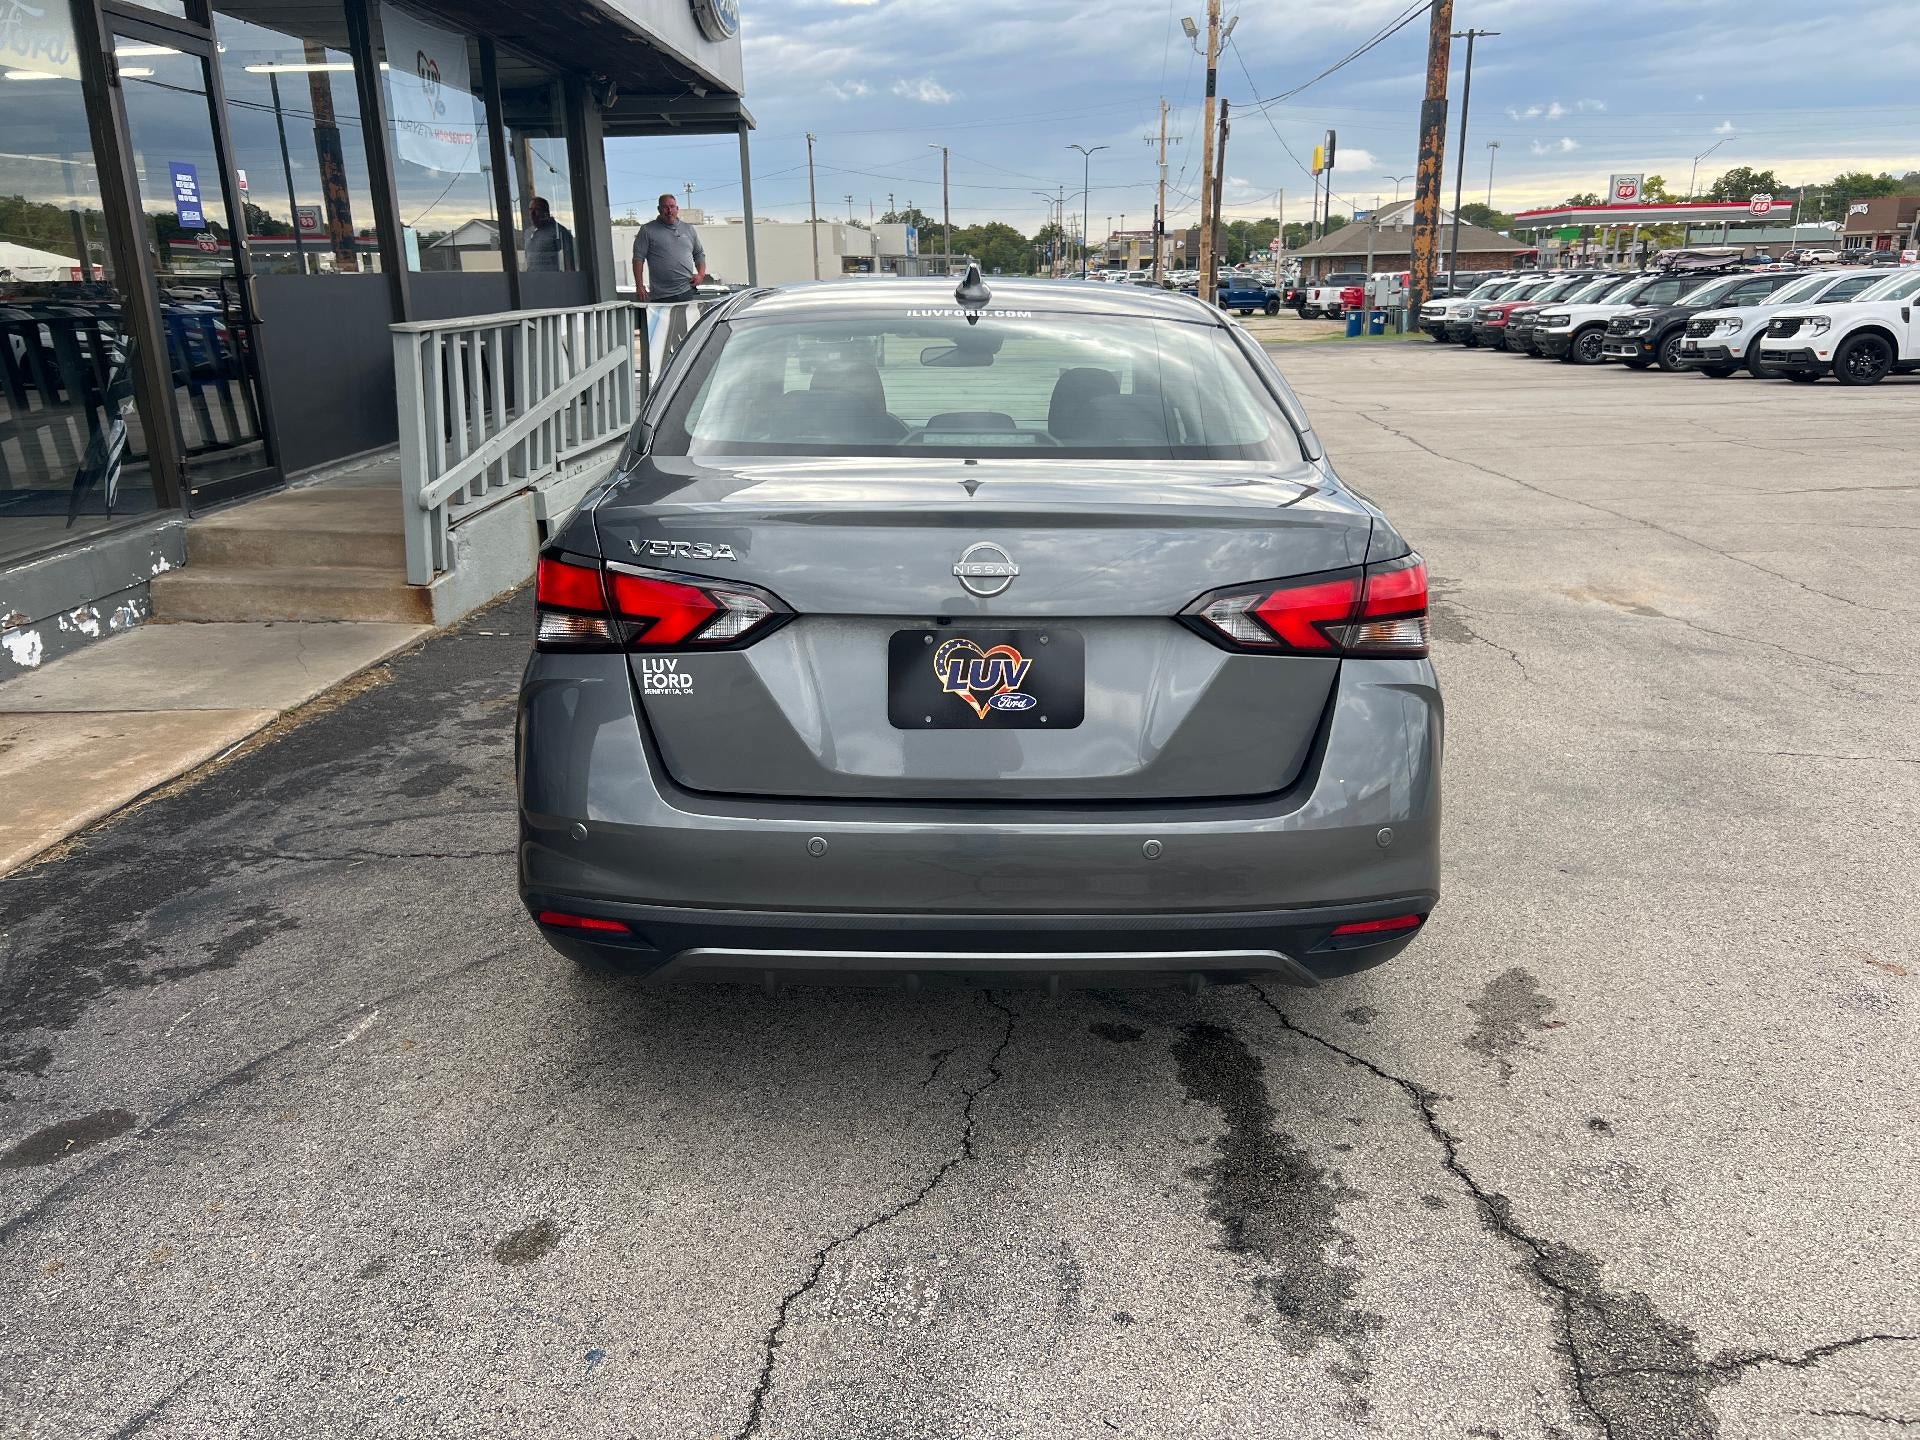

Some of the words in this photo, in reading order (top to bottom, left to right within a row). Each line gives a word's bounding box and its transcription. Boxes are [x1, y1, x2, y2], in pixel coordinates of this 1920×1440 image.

[1619, 186, 1634, 196] 66
[1754, 202, 1769, 211] 66
[627, 539, 737, 561] VERSA
[953, 565, 1019, 575] NISSAN
[642, 658, 678, 673] LUV
[643, 673, 693, 689] FORD
[943, 659, 1033, 692] LUV
[997, 695, 1027, 708] Ford
